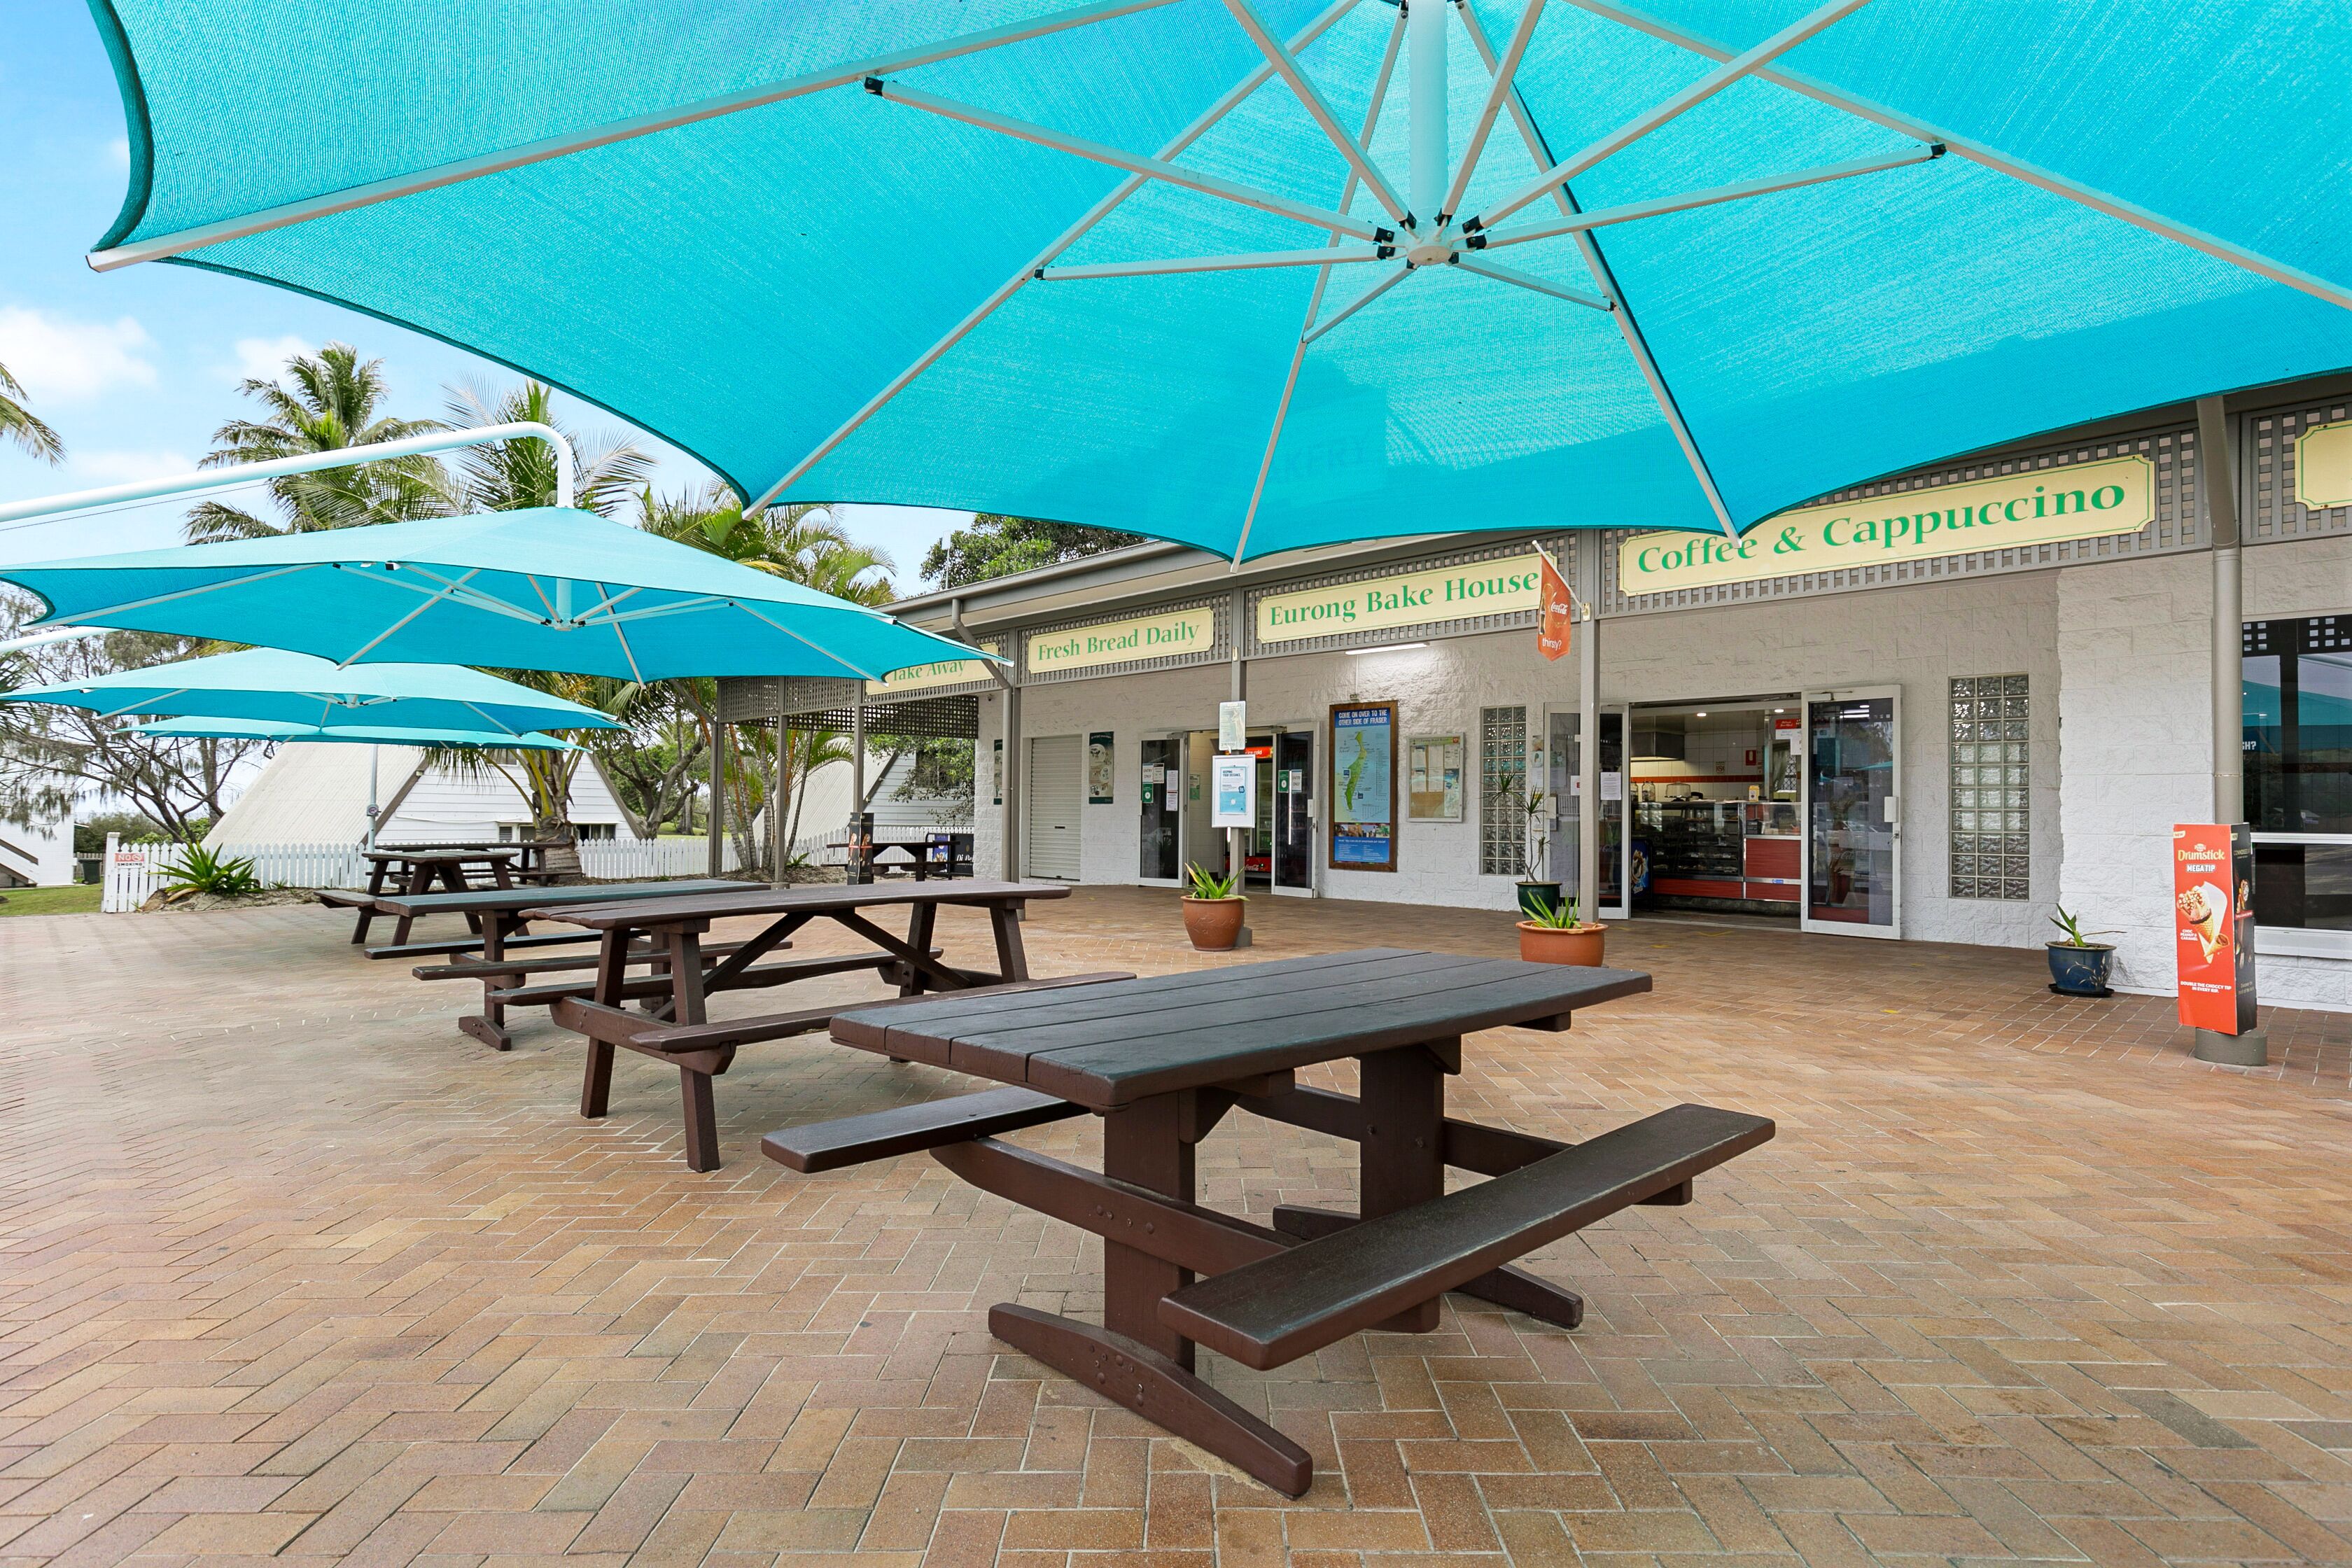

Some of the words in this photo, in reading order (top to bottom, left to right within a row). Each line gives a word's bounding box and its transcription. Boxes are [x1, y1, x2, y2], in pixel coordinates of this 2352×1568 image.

[1639, 536, 1758, 573] Coffee
[1774, 526, 1807, 554] &
[1822, 483, 2126, 550] Cappuccino
[1270, 598, 1357, 626] Eurong
[1366, 585, 1434, 612] Bake
[1444, 572, 1540, 602] House
[1038, 638, 1080, 661] Fresh
[1087, 629, 1138, 654] Bread
[1147, 622, 1200, 645] Daily
[1542, 638, 1562, 651] thirsty?
[927, 661, 966, 677] Away
[2178, 848, 2225, 862] Drumstick
[2187, 864, 2204, 872] MEGA
[2205, 864, 2216, 872] TIP
